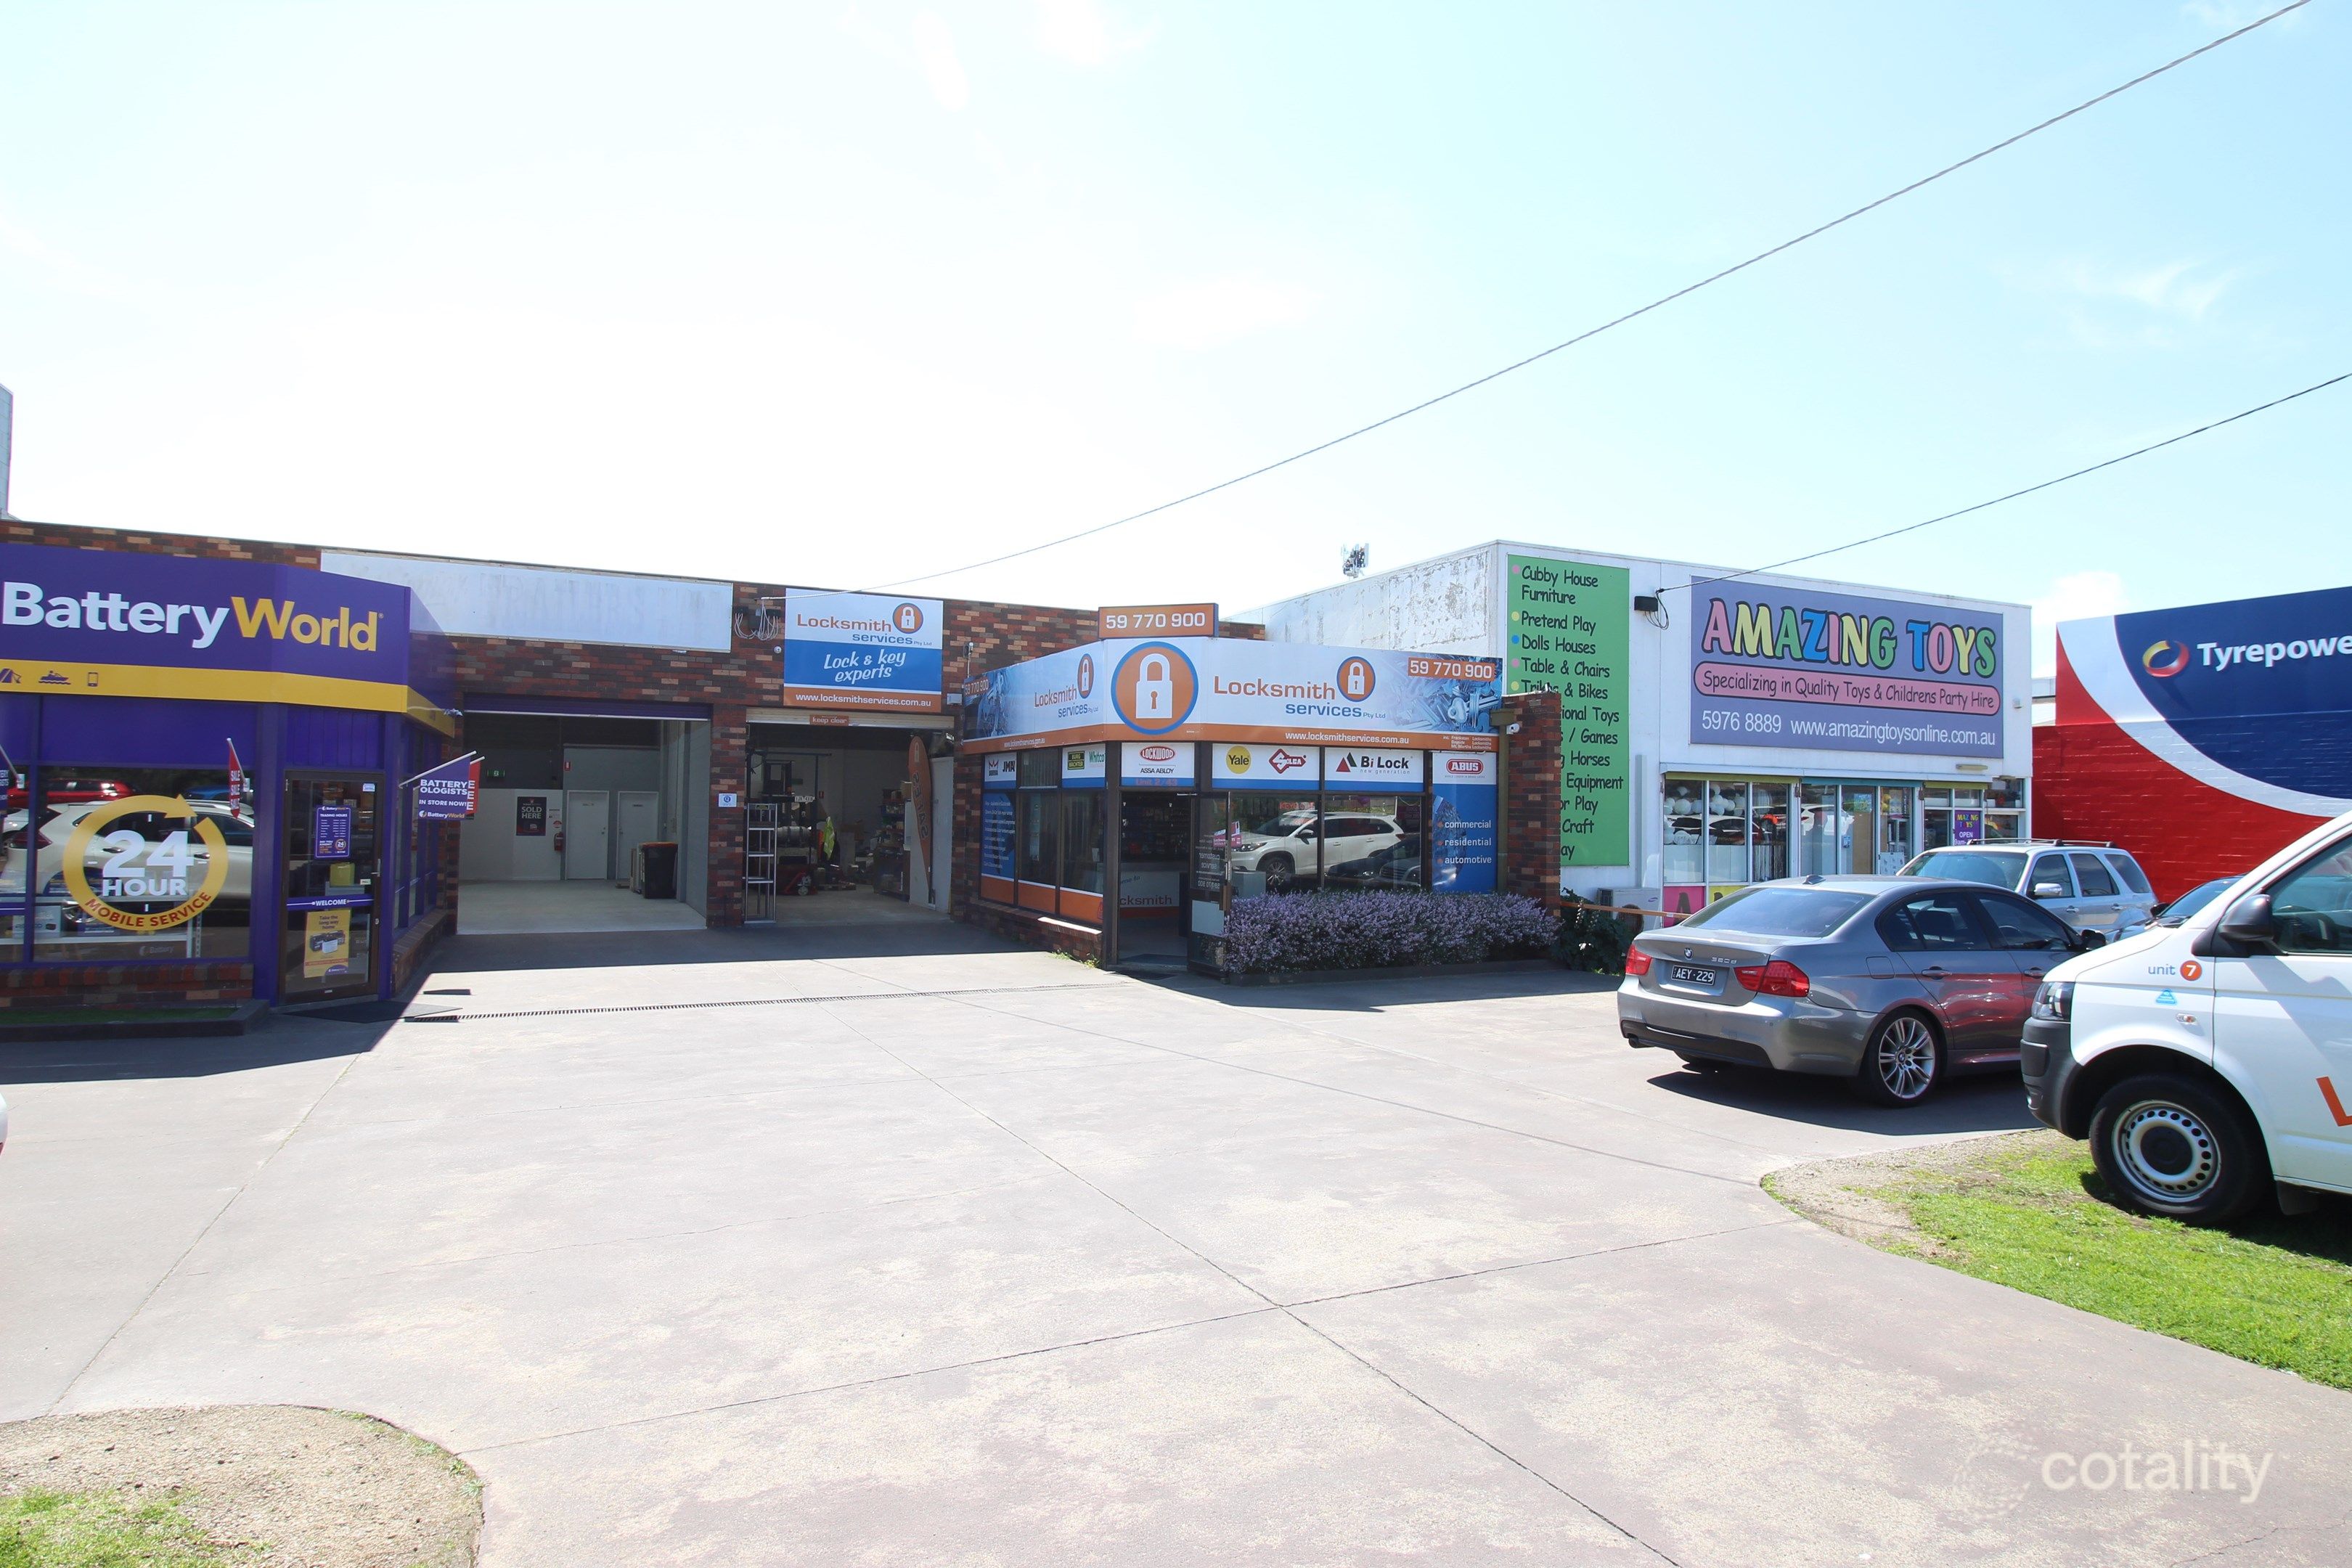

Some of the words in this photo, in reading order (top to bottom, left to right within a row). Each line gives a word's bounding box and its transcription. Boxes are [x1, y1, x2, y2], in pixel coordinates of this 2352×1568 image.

[1522, 565, 1559, 587] Cubby
[1564, 569, 1598, 587] House
[1522, 584, 1576, 605] Furniture
[797, 613, 892, 632] Locksmith
[1106, 615, 1127, 629] 59
[1132, 613, 1167, 628] 770
[1171, 612, 1206, 627] 900
[1521, 610, 1568, 629] Pretend
[1572, 616, 1596, 637] Play
[852, 632, 913, 645] services
[1522, 633, 1550, 650] Dolls
[1556, 636, 1596, 654] Houses
[1702, 597, 1897, 670] AMAZING
[1906, 618, 1996, 679] TOYS
[823, 650, 860, 669] Lock
[863, 656, 873, 666] &
[878, 648, 907, 667] key
[2197, 634, 2352, 671] Tyrepowe
[834, 664, 892, 685] experts
[1410, 660, 1429, 674] 59
[1433, 661, 1461, 677] 770
[1465, 664, 1492, 679] 900
[1521, 656, 1555, 674] Table
[1561, 660, 1569, 675] &
[1575, 661, 1610, 678] Chairs
[965, 683, 971, 695] 59
[971, 681, 980, 694] 770
[980, 679, 989, 691] 900
[1214, 675, 1336, 701] Locksmith
[1521, 679, 1559, 693] Triks
[1564, 682, 1574, 698] &
[1578, 682, 1609, 700] Bikes
[1703, 670, 1777, 698] Specializing
[1781, 674, 1792, 693] in
[1795, 677, 1839, 702] Quality
[1843, 681, 1871, 703] Toys
[1874, 683, 1883, 701] &
[1885, 685, 1937, 704] Childrens
[1939, 688, 1969, 711] Party
[1971, 691, 1994, 709] Hire
[796, 693, 931, 707] www.locksmithservices.com.au
[1034, 685, 1077, 708] Locksmith
[1058, 703, 1088, 718] services
[1285, 702, 1362, 718] services
[1592, 706, 1620, 727] Toys
[1580, 728, 1618, 745] Games
[1702, 710, 1740, 732] 5976
[1744, 713, 1782, 734] 8889
[1790, 718, 1996, 746] www.amazingtoysonline.com.au
[1285, 731, 1409, 745] www.locksmithservices.com.au
[1089, 751, 1104, 763] Whitco
[1142, 747, 1174, 760] LOCKWOOD
[1228, 754, 1249, 766] Yale
[1360, 755, 1374, 768] Bi
[1379, 756, 1409, 769] Lock
[1570, 750, 1610, 767] Horses
[1003, 761, 1016, 772] JMA
[1451, 761, 1479, 771] ABUS
[420, 779, 467, 788] BATTERY
[1566, 772, 1624, 793] Equipment
[420, 787, 468, 796] OLOGISTS
[1575, 796, 1598, 816] Play
[1445, 820, 1491, 828] commercial
[1562, 818, 1595, 834] Craft
[1445, 837, 1492, 846] residential
[102, 829, 195, 878] 24
[1445, 855, 1492, 864] automotive
[102, 878, 187, 897] HOUR
[1120, 895, 1172, 906] cksmith
[85, 898, 144, 928] MOBILE
[150, 891, 212, 928] SERVICE
[2148, 963, 2176, 976] unit
[2186, 964, 2197, 977] 7
